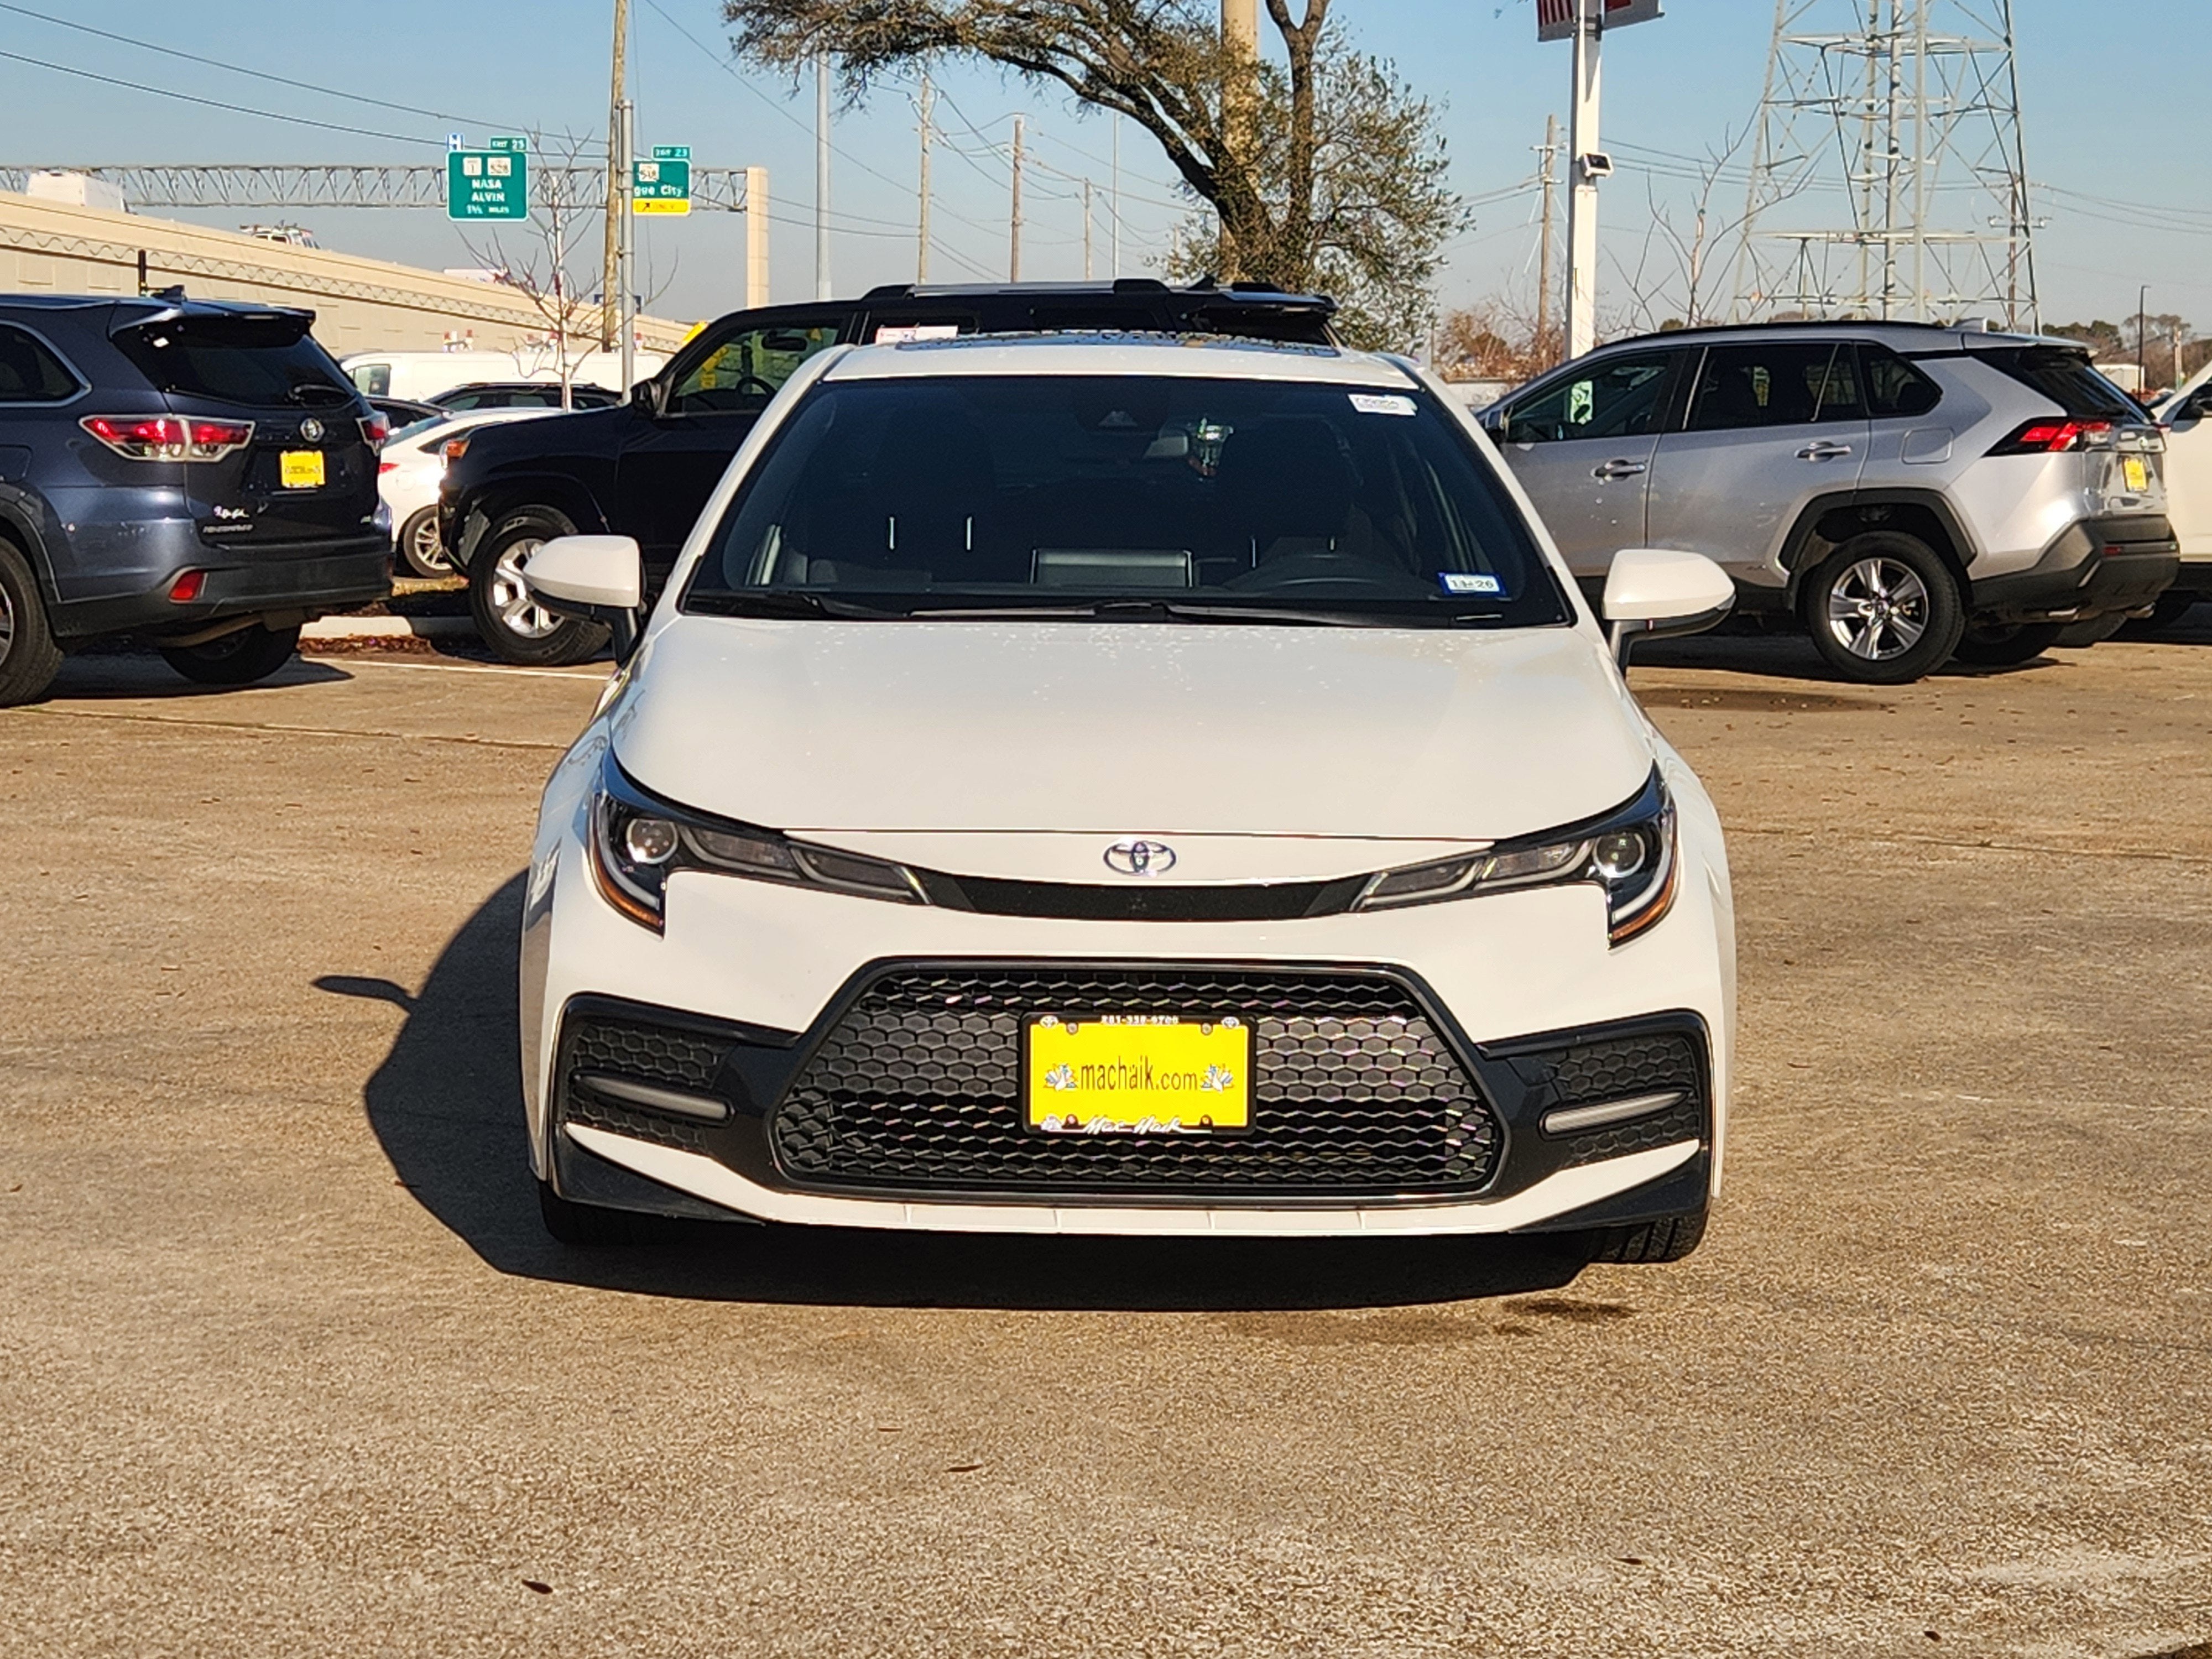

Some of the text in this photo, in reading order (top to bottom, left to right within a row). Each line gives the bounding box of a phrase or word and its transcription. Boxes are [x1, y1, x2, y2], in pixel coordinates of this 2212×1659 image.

[675, 148, 688, 156] 23
[472, 179, 502, 189] NASA
[634, 184, 684, 197] gue City
[472, 192, 505, 202] ALVIN
[1081, 1056, 1197, 1091] machaik.com
[1084, 1114, 1127, 1135] Mac
